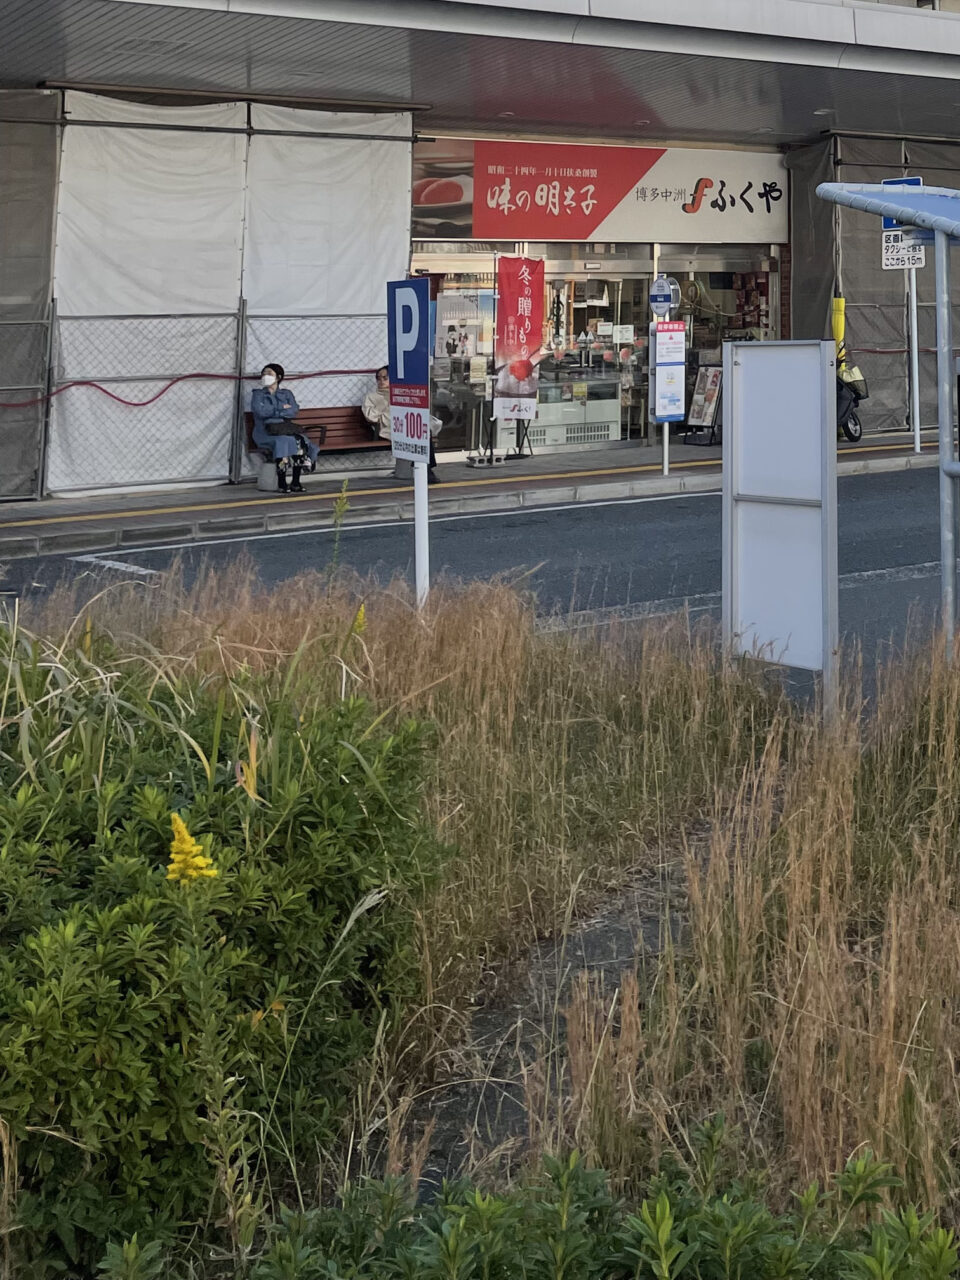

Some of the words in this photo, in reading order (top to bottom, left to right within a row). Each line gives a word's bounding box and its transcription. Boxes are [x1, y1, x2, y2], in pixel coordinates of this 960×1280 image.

[635, 187, 686, 202] 博多中洲
[710, 180, 783, 214] ふくや
[885, 233, 904, 244] 区画
[395, 287, 420, 379] P
